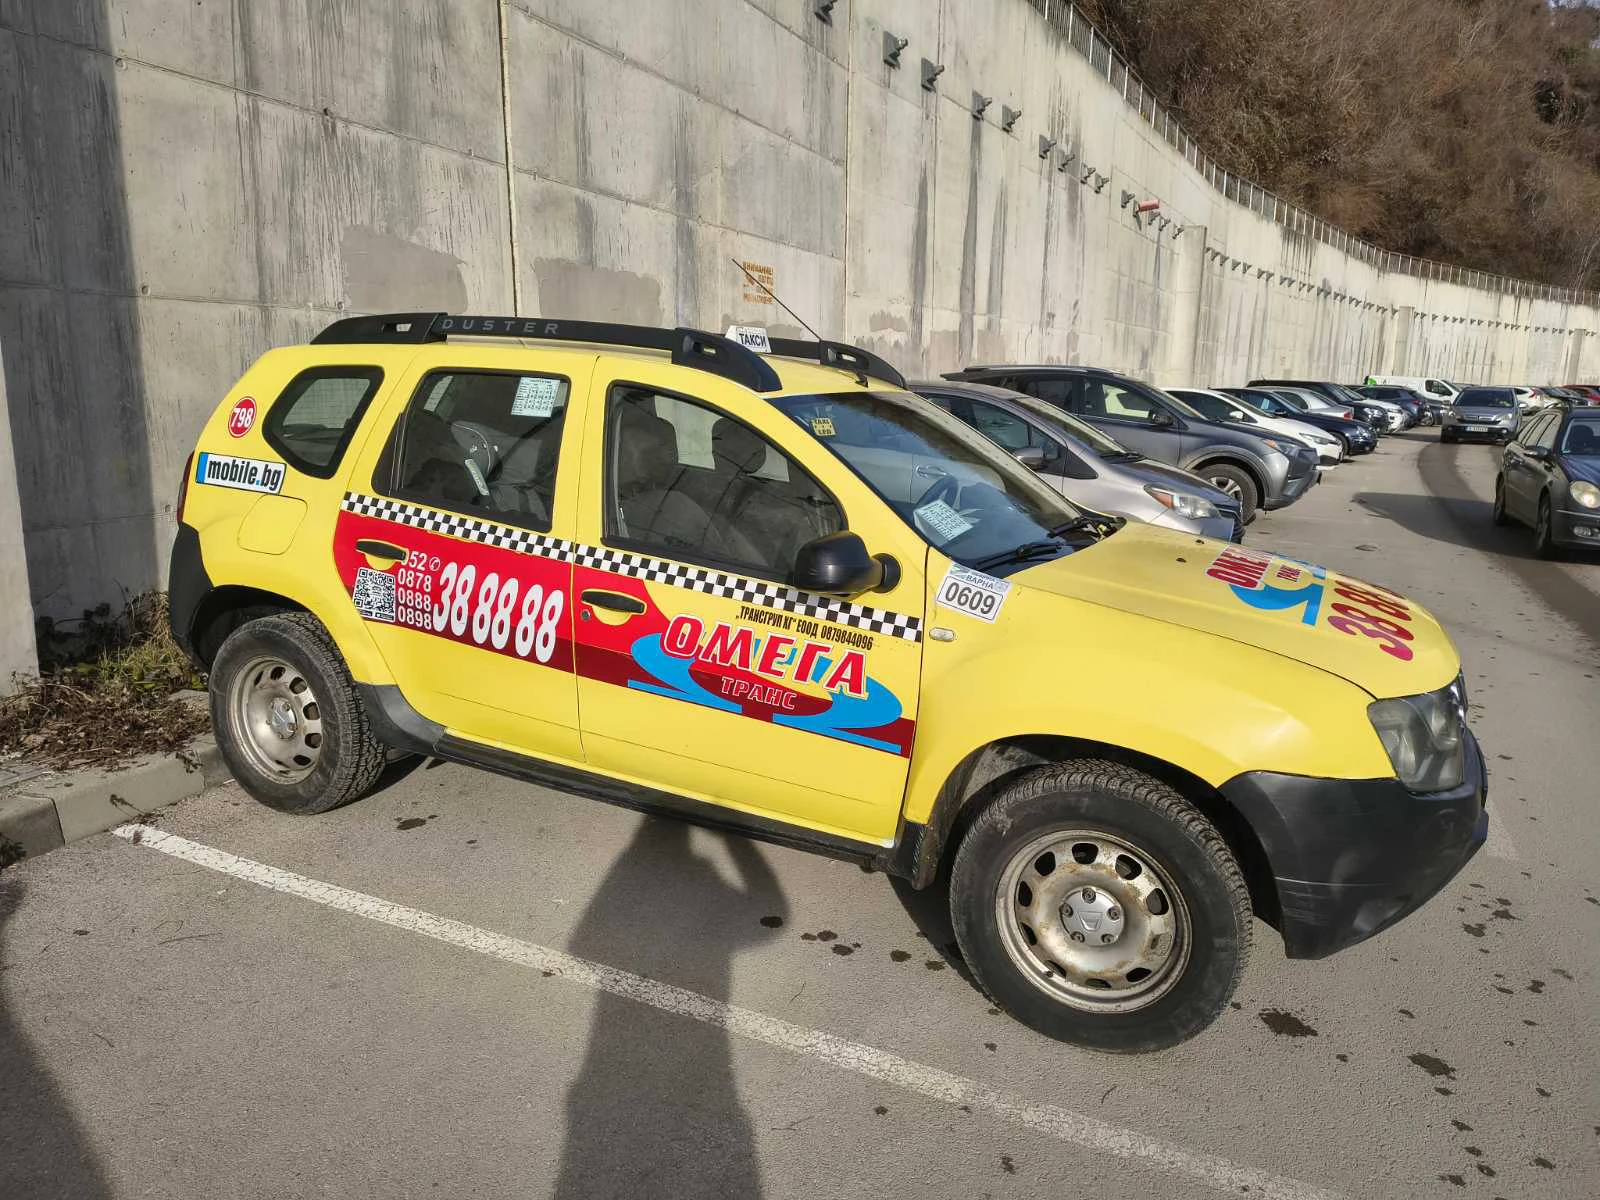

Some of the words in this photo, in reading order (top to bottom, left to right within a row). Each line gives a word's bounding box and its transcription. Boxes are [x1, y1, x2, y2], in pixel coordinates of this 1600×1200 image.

[442, 319, 558, 334] DUSTER
[739, 333, 767, 347] ТАКСИ
[231, 407, 254, 428] 798
[207, 459, 282, 491] mobile.bg
[398, 568, 432, 592] 0878
[398, 587, 432, 612] 0888
[945, 582, 995, 614] 0609
[398, 605, 432, 630] 0898
[796, 619, 819, 639] ЕООД
[821, 625, 874, 651] 0879844096
[664, 614, 868, 700] ОМЕГА
[721, 676, 798, 711] ТРАНС
